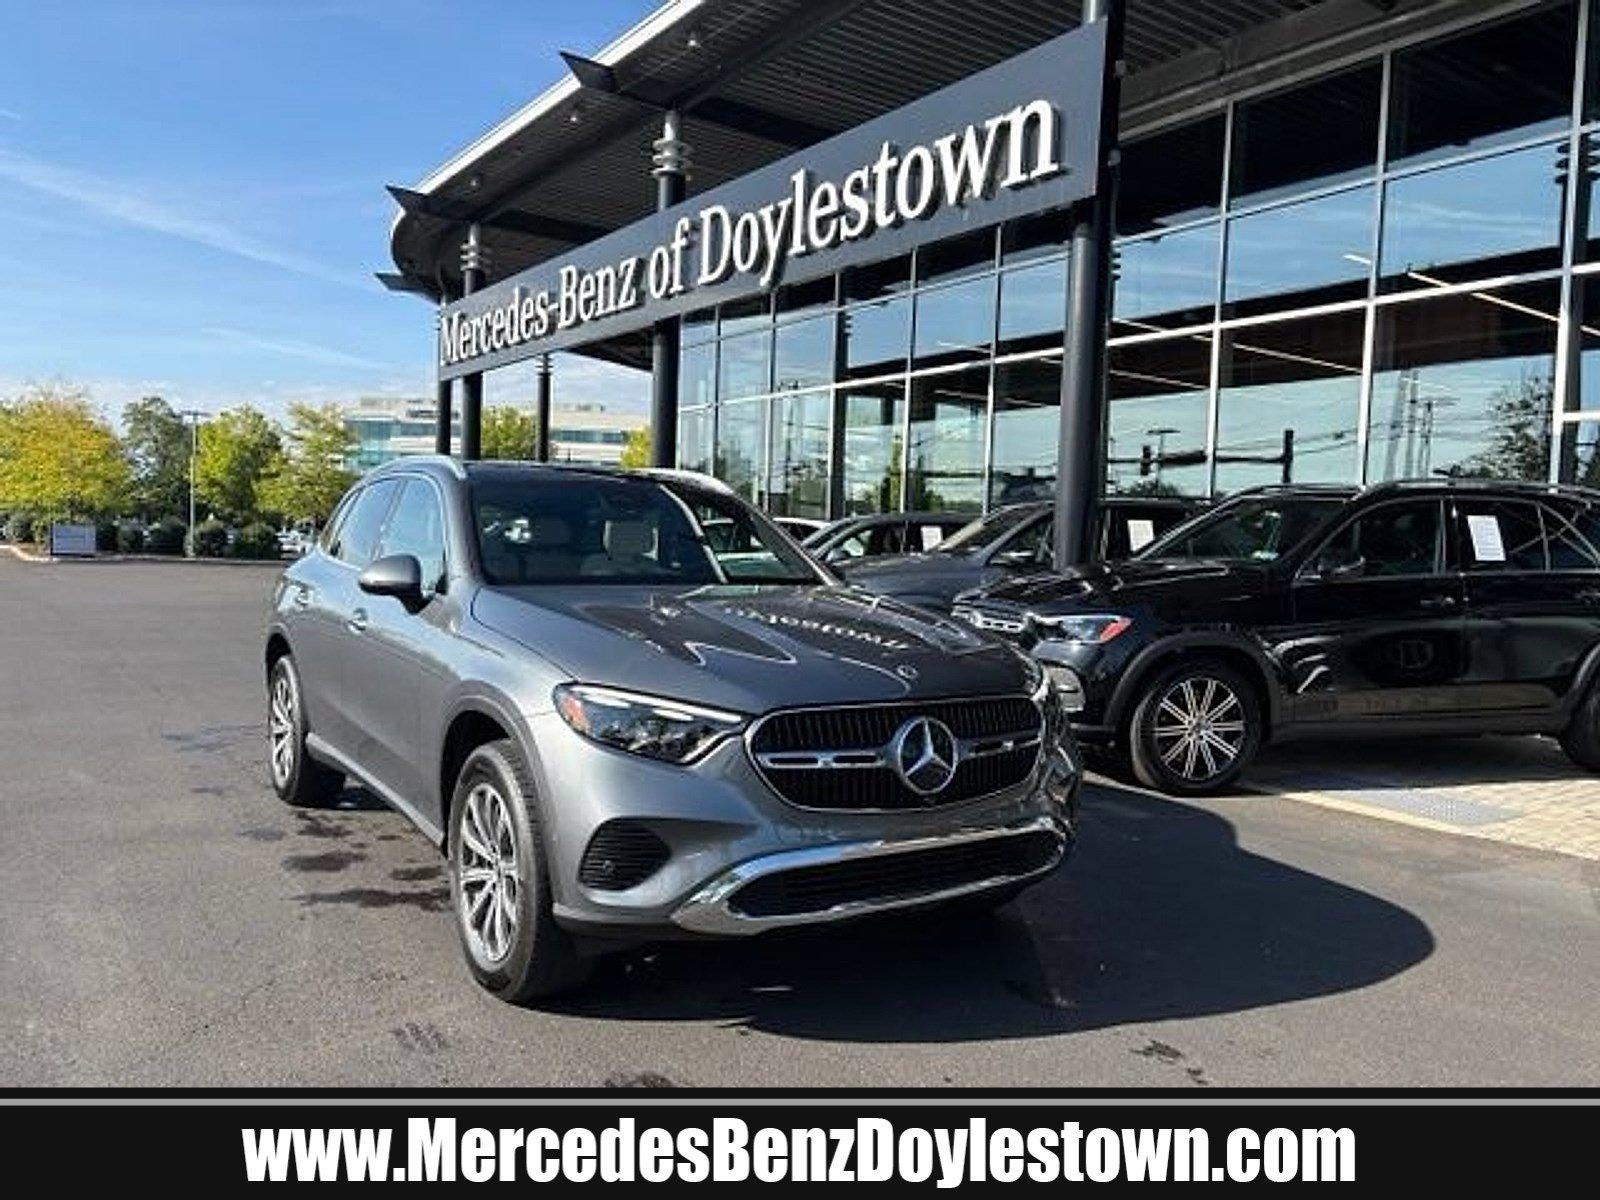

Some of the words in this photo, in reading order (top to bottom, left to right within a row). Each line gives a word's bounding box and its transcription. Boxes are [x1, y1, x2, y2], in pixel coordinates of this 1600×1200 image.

[438, 262, 638, 368] Mercedes-Benz
[647, 216, 692, 300] of
[697, 97, 1062, 288] Doylestown
